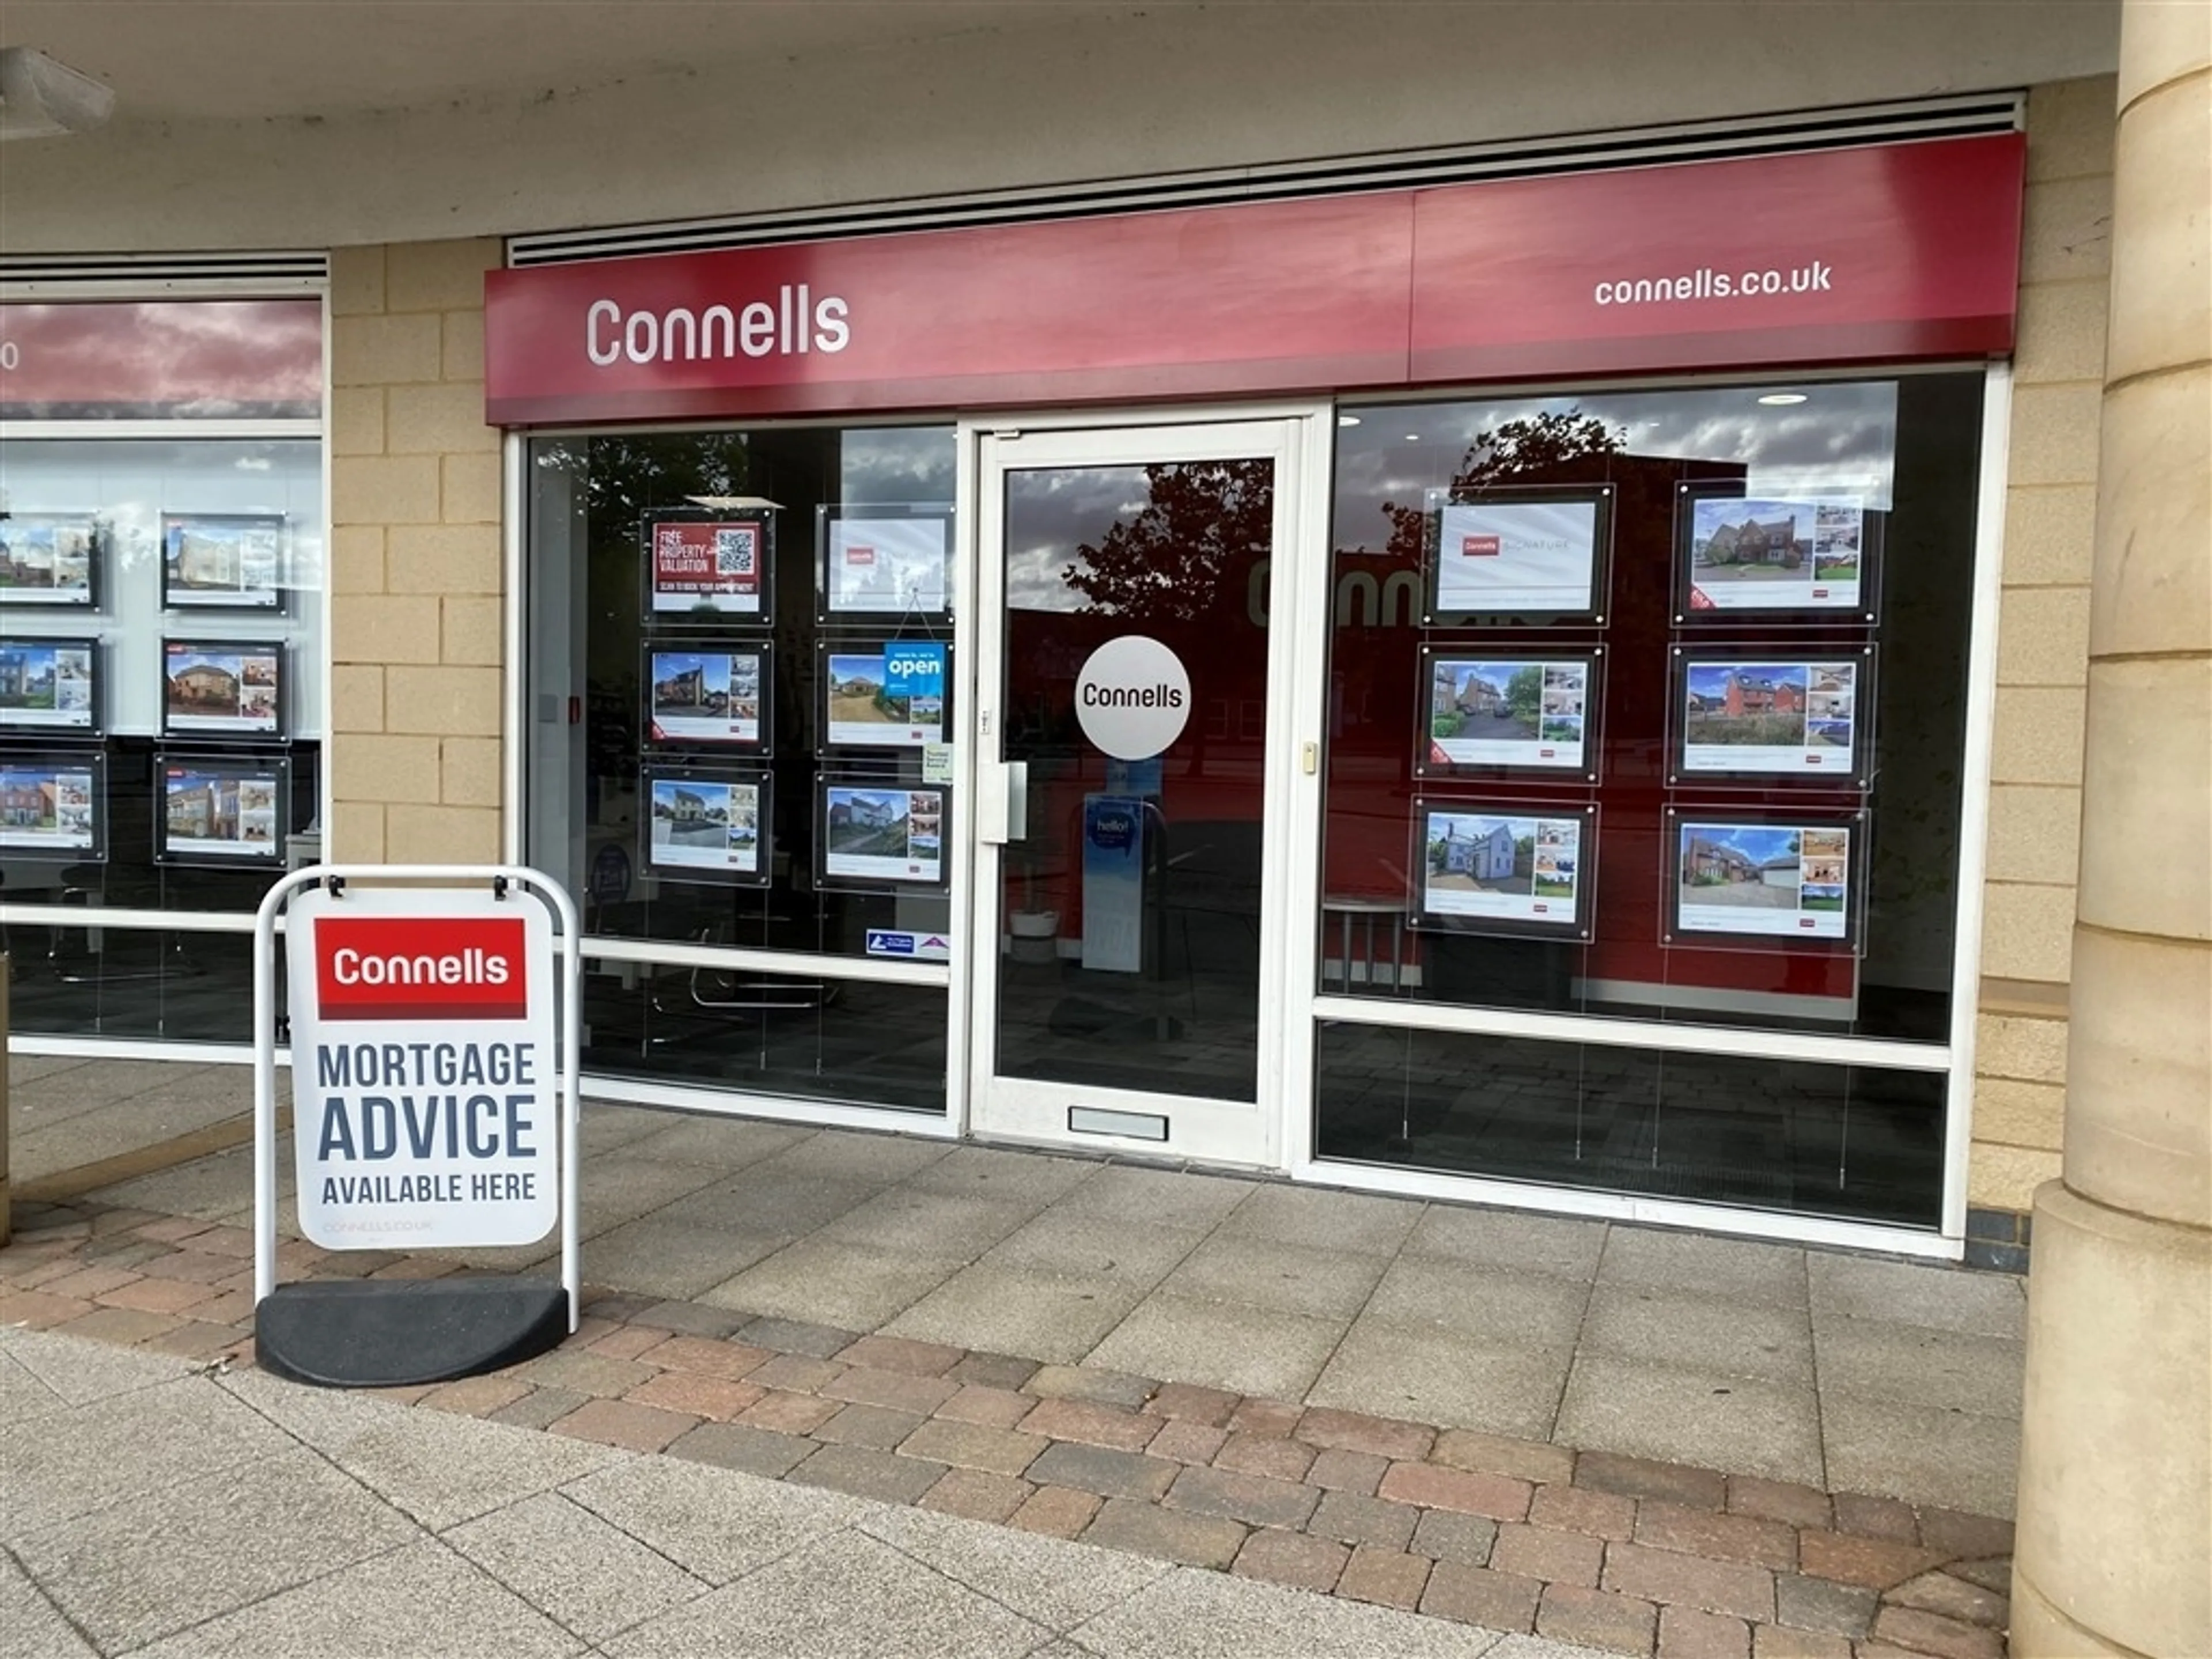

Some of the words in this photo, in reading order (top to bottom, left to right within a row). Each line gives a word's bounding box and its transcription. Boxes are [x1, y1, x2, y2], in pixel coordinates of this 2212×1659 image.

[1595, 261, 1832, 305] connells.co.uk
[586, 283, 850, 366] Connells
[660, 530, 683, 544] FREE
[660, 544, 707, 558] PROPERTY
[660, 559, 709, 573] VALUATION
[889, 660, 940, 679] open
[1084, 682, 1183, 707] Connells
[334, 948, 509, 985] Connells
[317, 1043, 536, 1088] MORTGAGE
[317, 1094, 537, 1161] ADVICE
[321, 1175, 463, 1205] AVAILABLE
[471, 1173, 536, 1201] HERE
